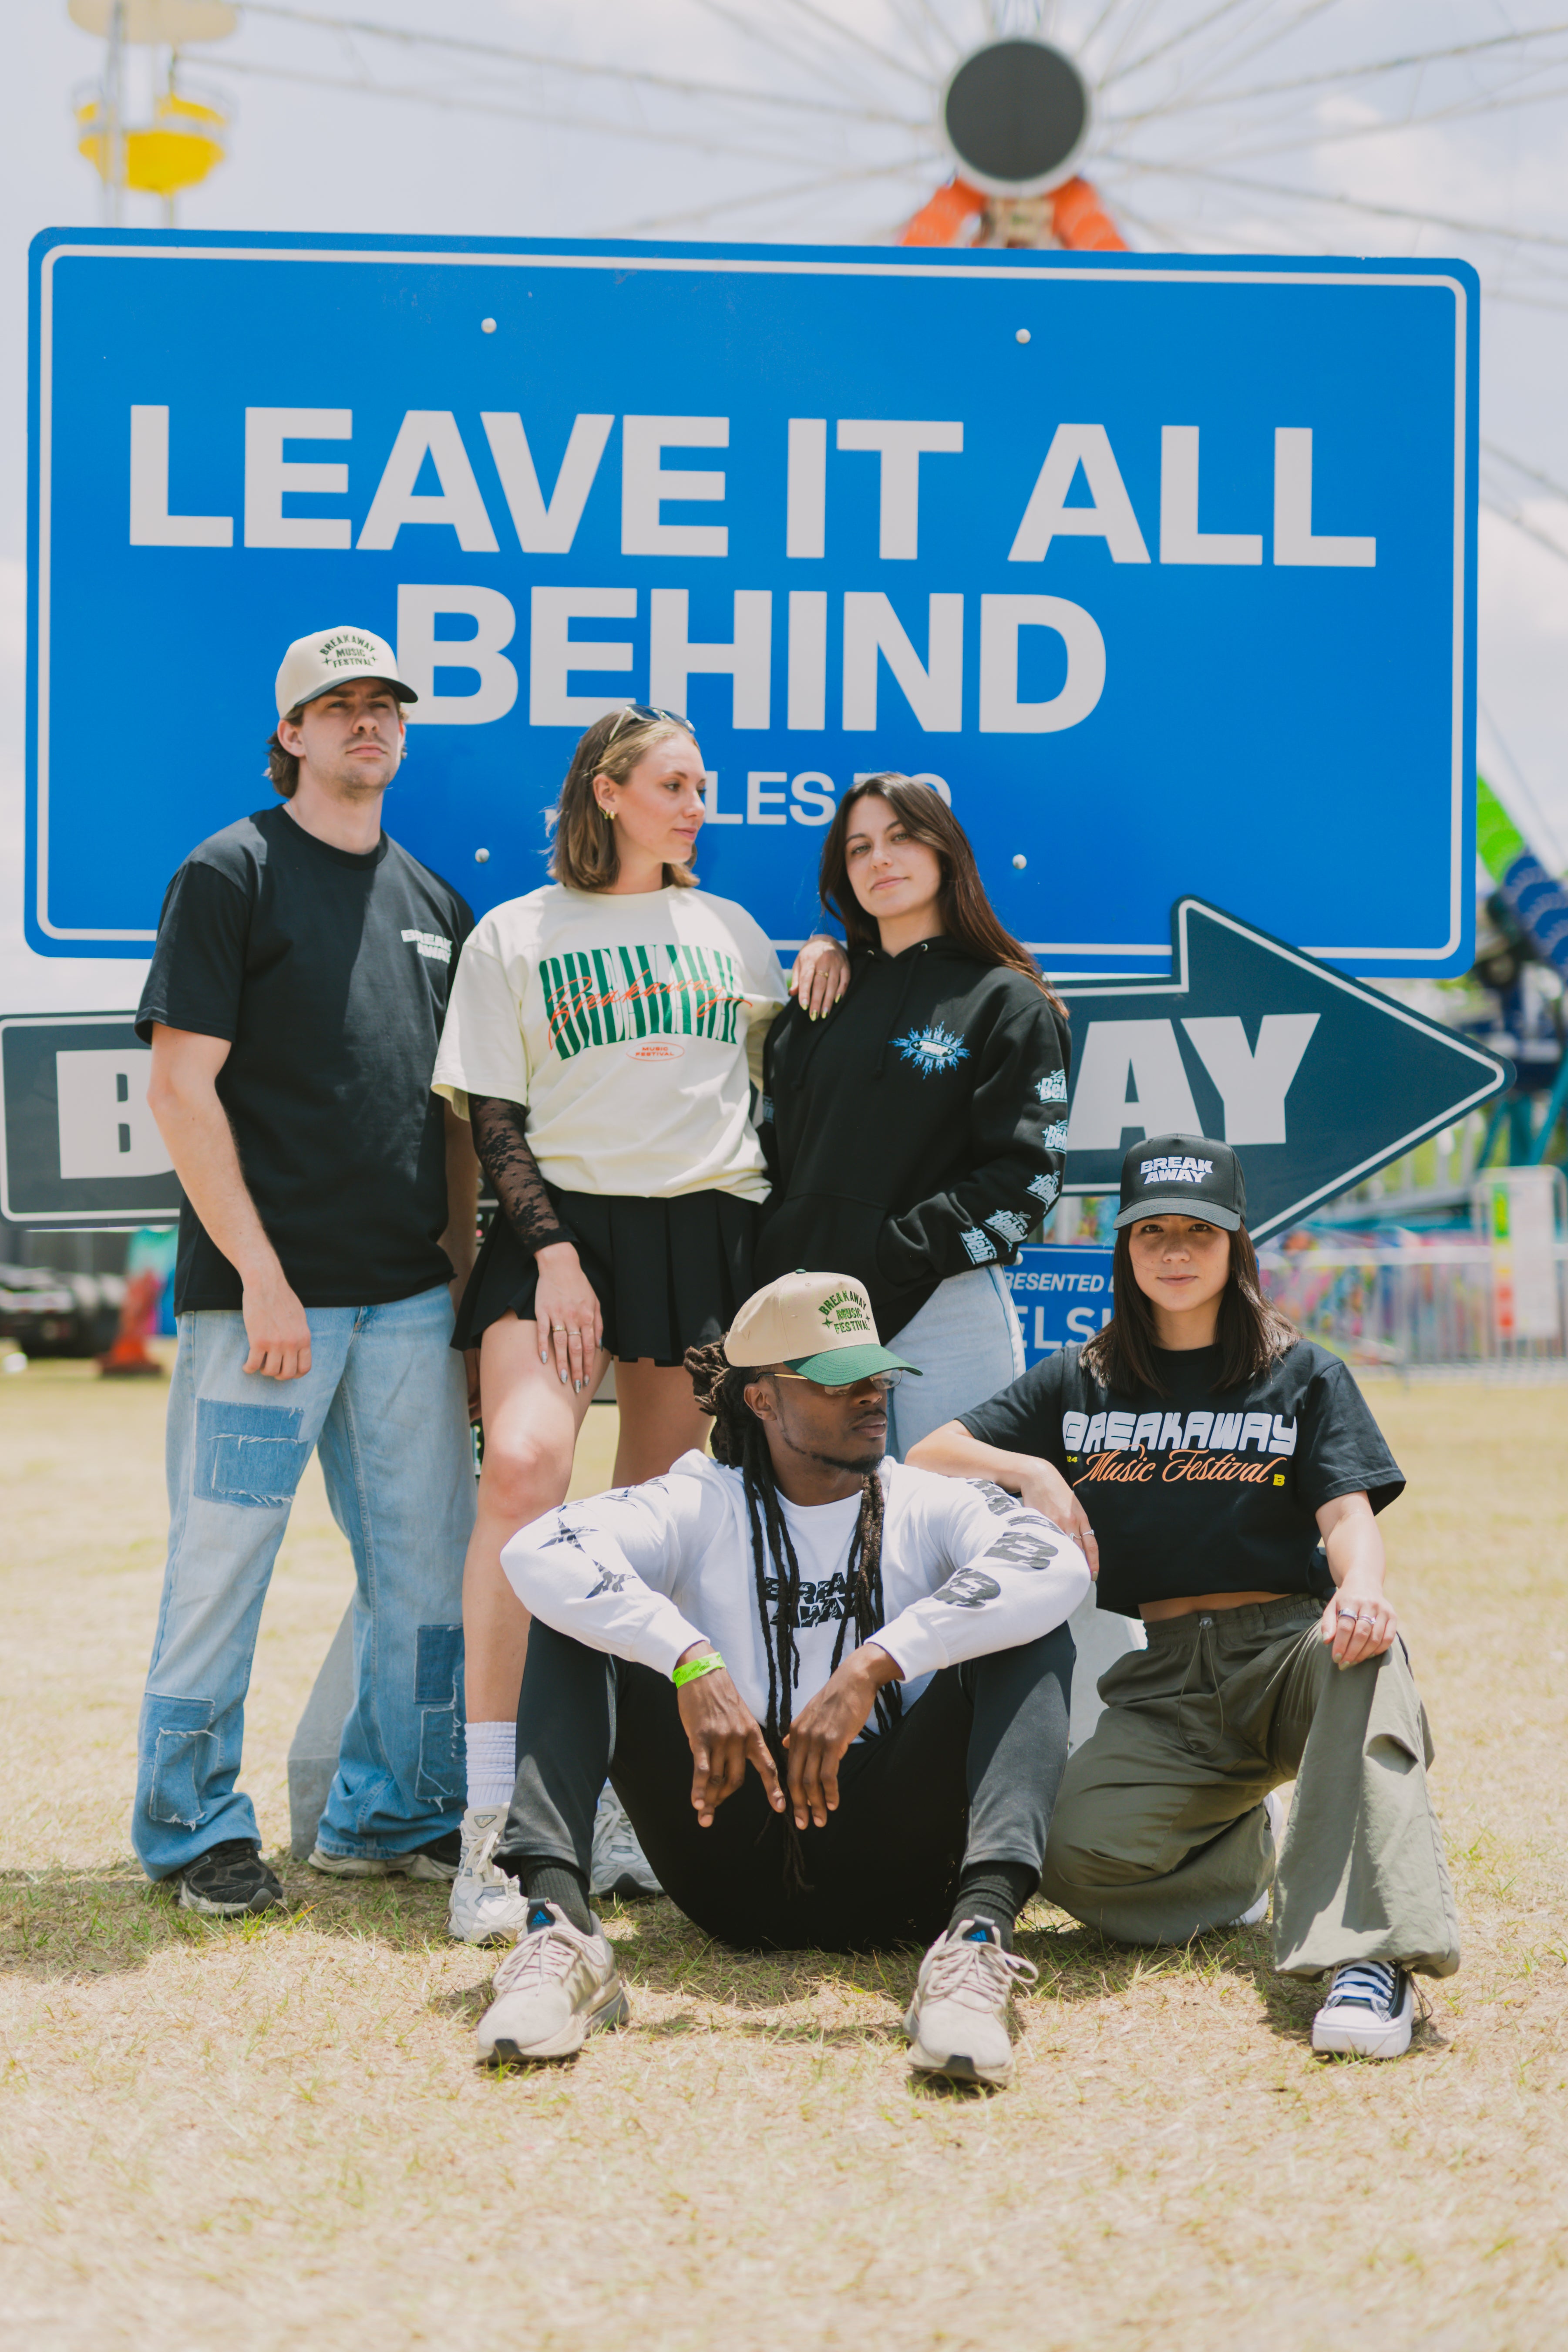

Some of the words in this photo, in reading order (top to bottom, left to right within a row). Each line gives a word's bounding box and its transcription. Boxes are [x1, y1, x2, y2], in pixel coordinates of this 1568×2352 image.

[130, 405, 729, 556] LEAVE
[787, 419, 963, 559] IT
[1008, 424, 1376, 567] ALL
[320, 634, 375, 655] BREAKAWAY
[336, 648, 365, 658] MUSIC
[333, 658, 373, 668] FESTIVAL
[397, 585, 1106, 733] BEHIND
[704, 771, 836, 826] LES
[1140, 1156, 1213, 1175] BREAK
[1144, 1168, 1206, 1185] AWAY
[1004, 1272, 1105, 1292] RESENTED
[818, 1290, 867, 1316] BREAKAWAY
[836, 1307, 863, 1321] MUSIC
[834, 1319, 870, 1334] FESTIVAL
[1062, 1410, 1297, 1456] BREAKAWAY
[1073, 1444, 1156, 1487] Music
[1162, 1449, 1287, 1483] Festival
